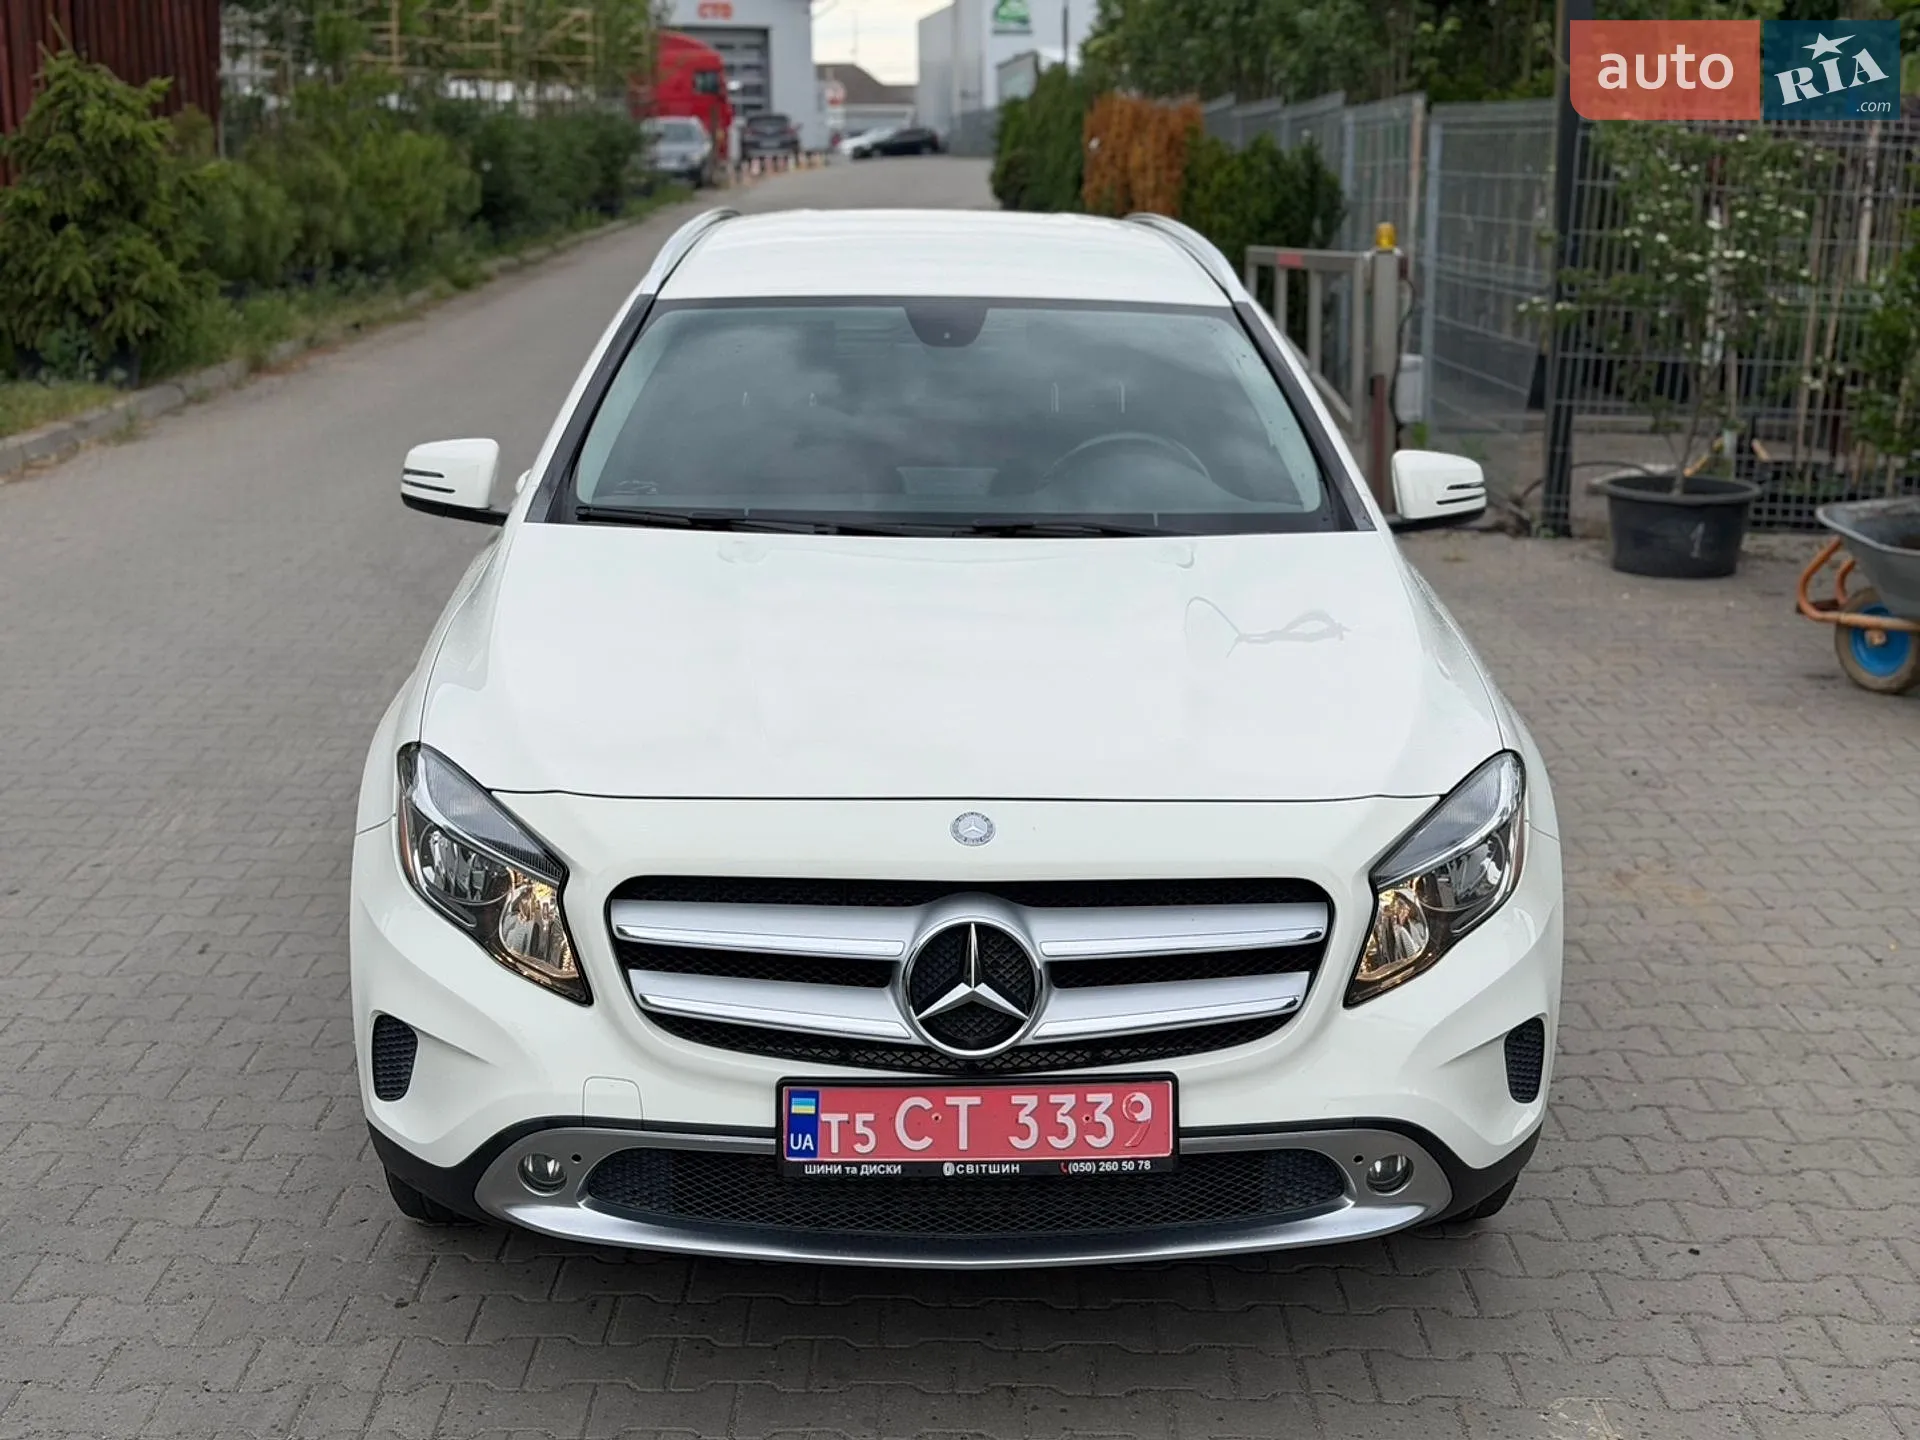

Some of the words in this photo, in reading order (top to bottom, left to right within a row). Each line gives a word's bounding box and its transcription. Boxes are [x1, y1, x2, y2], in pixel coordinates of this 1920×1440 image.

[1689, 522, 1705, 558] 1
[1008, 1092, 1153, 1150] 3339
[790, 1133, 815, 1151] UA
[804, 1164, 842, 1175] ШИНИ
[859, 1164, 902, 1176] ДИСКИ
[956, 1163, 1020, 1175] СВІТШИН
[1068, 1161, 1096, 1174] (050)
[1098, 1161, 1119, 1172] 260
[1121, 1160, 1135, 1171] 50
[1137, 1160, 1151, 1170] 78
